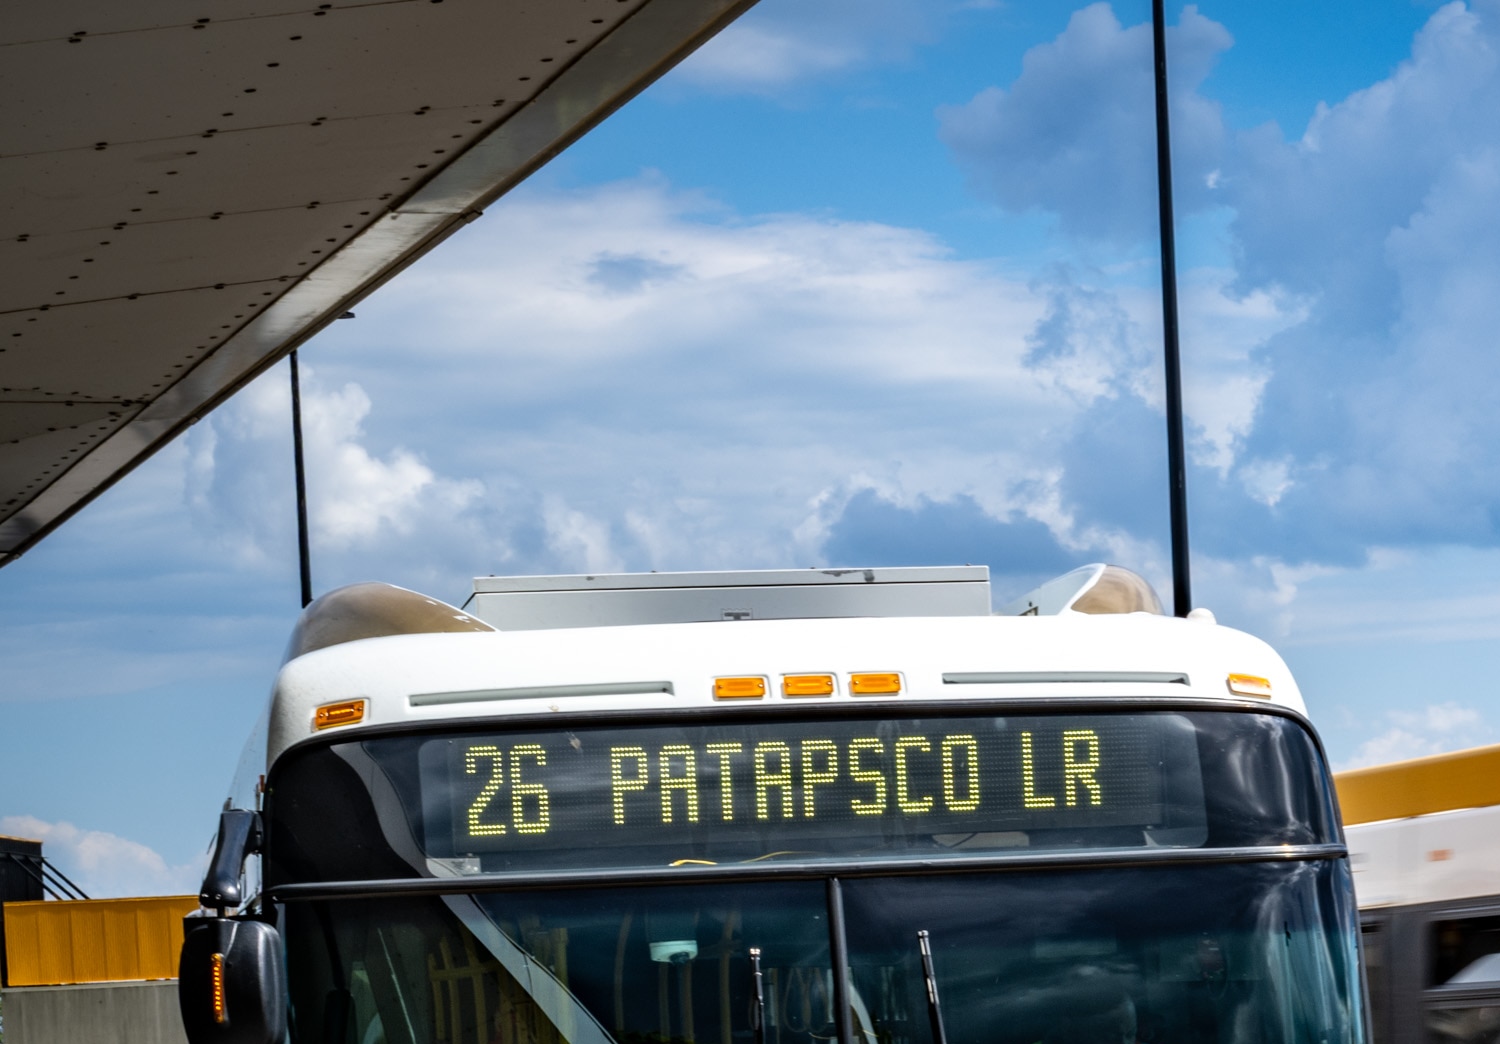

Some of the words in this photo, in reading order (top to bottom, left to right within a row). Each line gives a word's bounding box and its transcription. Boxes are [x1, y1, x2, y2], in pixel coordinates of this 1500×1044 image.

[465, 743, 550, 836] 26
[611, 733, 980, 826] PATAPSCO
[1021, 729, 1101, 809] LR
